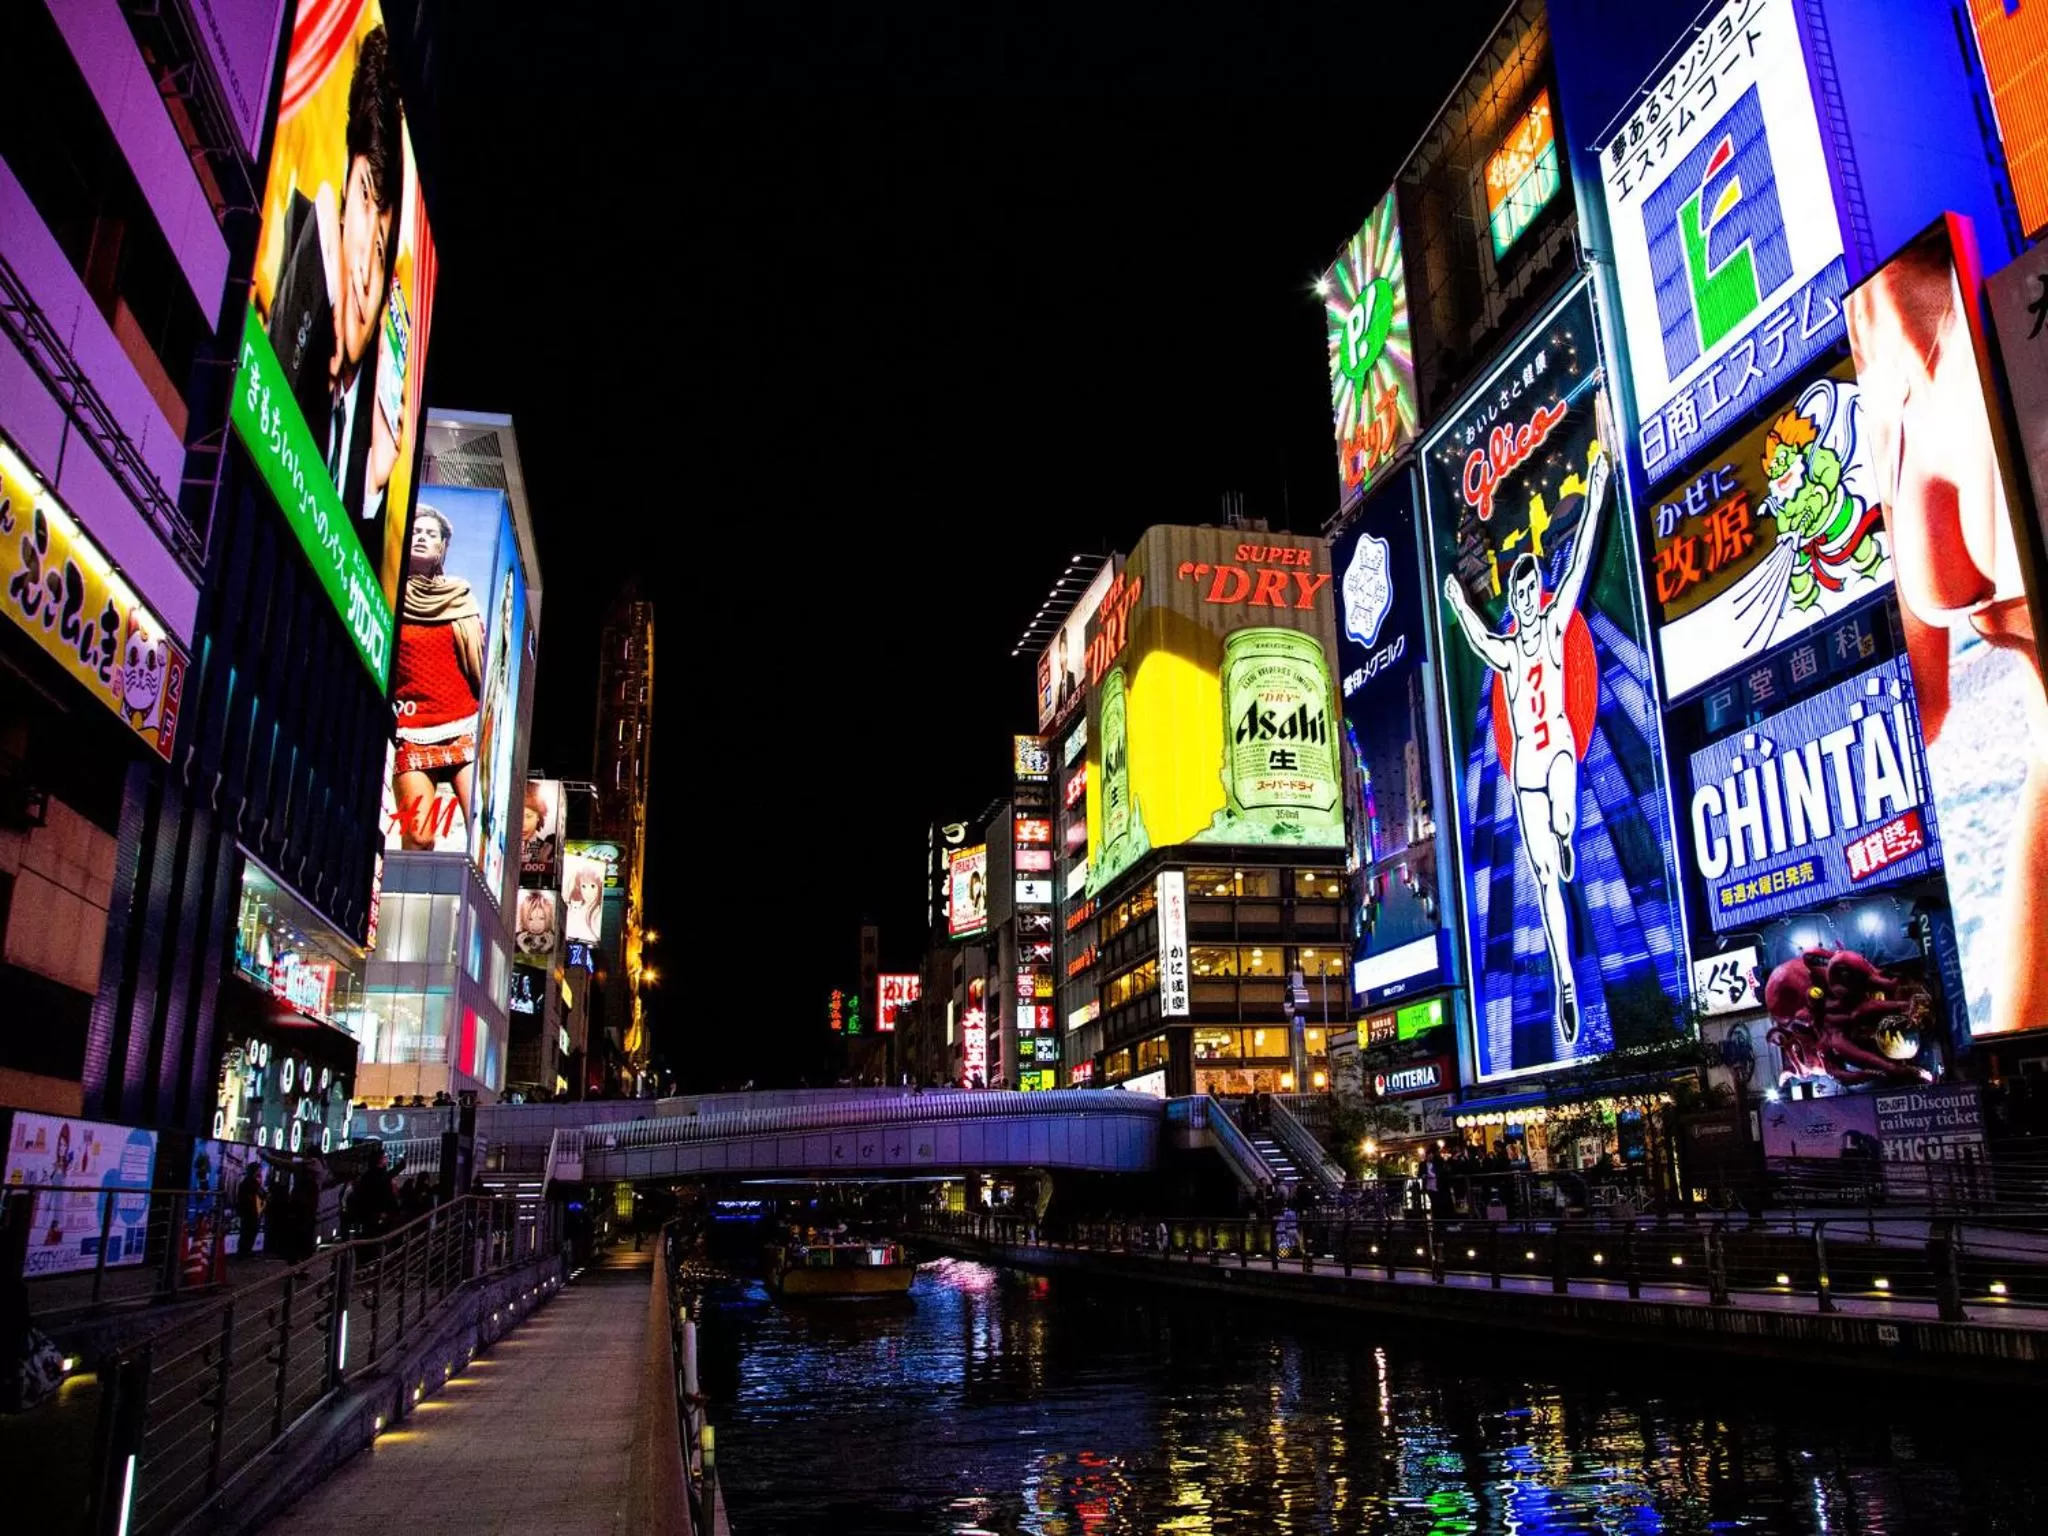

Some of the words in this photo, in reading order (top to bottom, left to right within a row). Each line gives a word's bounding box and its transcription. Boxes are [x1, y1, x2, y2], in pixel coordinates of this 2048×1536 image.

[1616, 30, 1761, 202] エステムコート
[1465, 350, 1548, 445] おいしさと健康
[1640, 286, 1839, 470] 日商エステム
[1463, 400, 1567, 521] Glico
[1656, 464, 1736, 537] かぜに
[1235, 544, 1312, 567] SUPER
[1653, 491, 1755, 604] 改源
[160, 664, 181, 746] 2F
[1236, 699, 1327, 747] Asahi
[1527, 656, 1551, 751] グリコ
[1269, 749, 1298, 771] 生
[1691, 680, 1925, 880] CHINTAI
[1256, 780, 1314, 793] スーパードライ
[1847, 831, 1888, 878] 賃貸
[1885, 819, 1907, 844] 住宅
[1886, 829, 1923, 859] ニュース
[1721, 861, 1814, 907] 毎週水曜日発売
[1920, 914, 1932, 955] 2F
[1707, 961, 1747, 1004] くくる
[1386, 1066, 1436, 1089] LOTTERIA
[1880, 1113, 1933, 1131] railway
[1936, 1108, 1980, 1126] ticket
[1911, 1093, 1977, 1111] Discount
